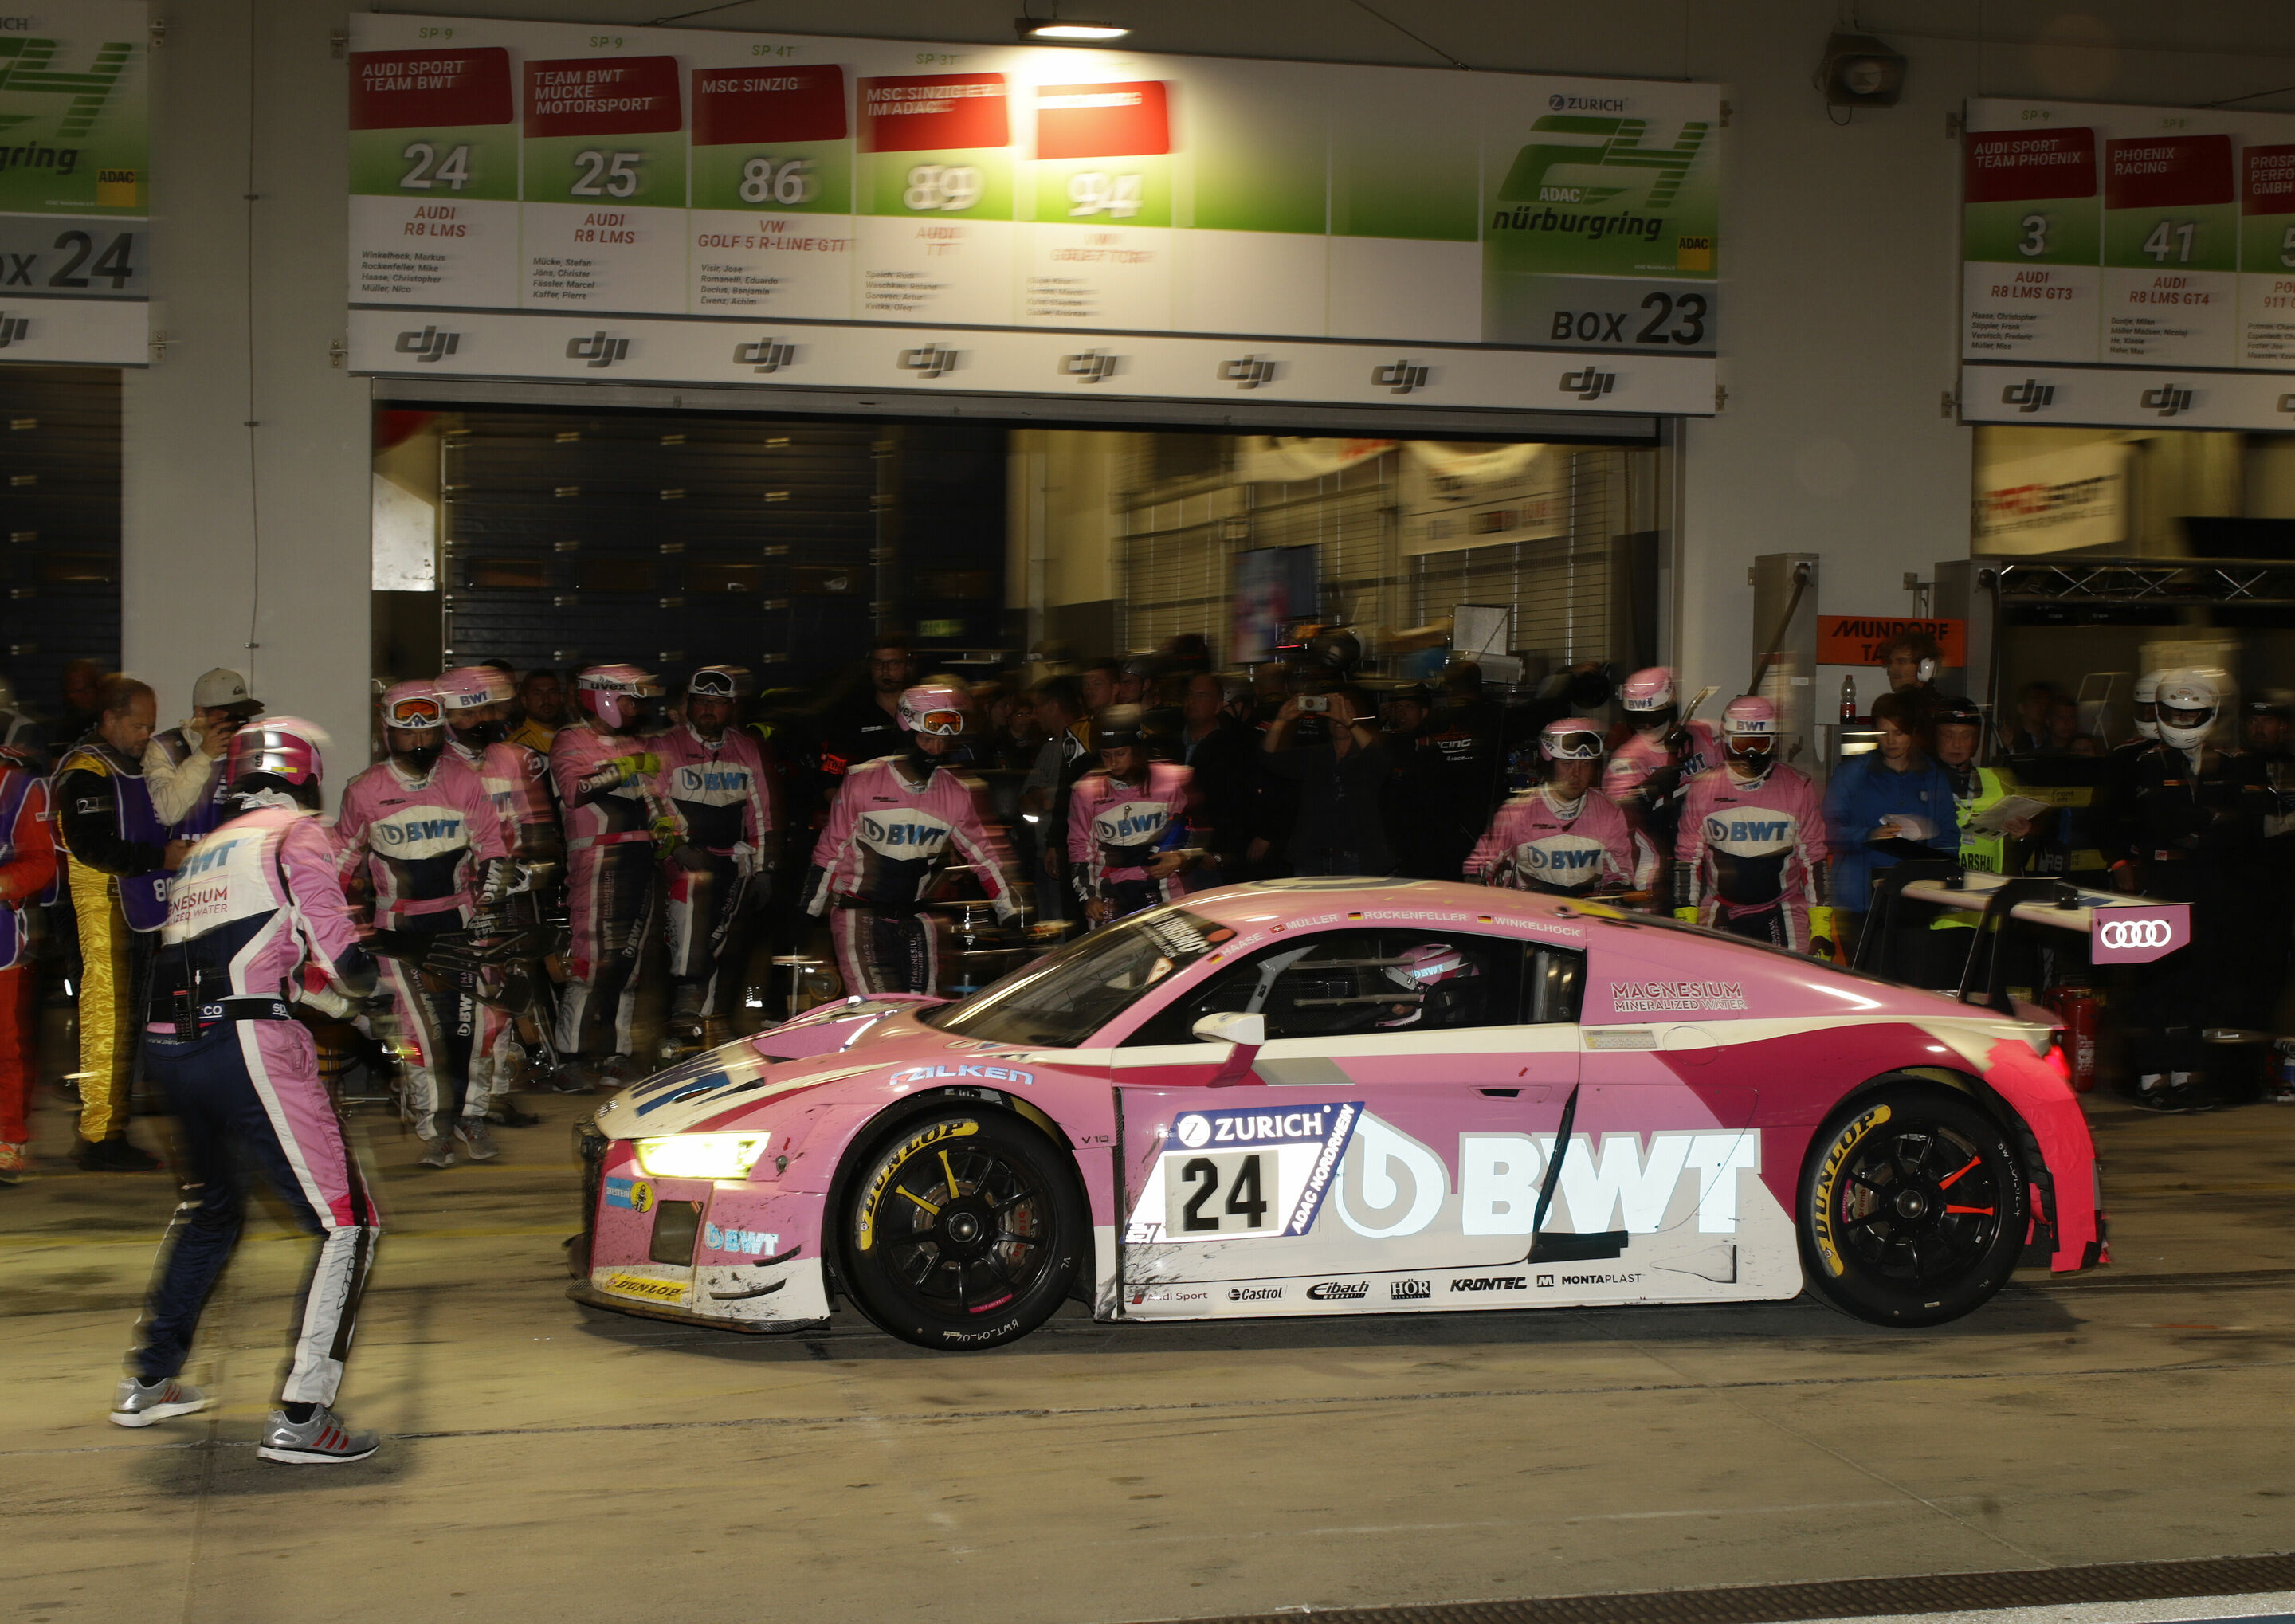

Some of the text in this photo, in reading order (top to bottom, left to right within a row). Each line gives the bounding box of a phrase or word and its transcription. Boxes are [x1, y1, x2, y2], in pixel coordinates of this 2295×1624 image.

[419, 27, 453, 39] SP 9
[589, 37, 622, 48] SP 9
[751, 45, 794, 57] SP 4T
[916, 53, 958, 65] SP 3T
[362, 61, 465, 76] AUDI SPORT
[365, 76, 457, 91] TEAM BWT
[534, 69, 624, 85] TEAM BWT
[701, 77, 798, 94] MSC SINZIG
[866, 84, 959, 102] MSC SINZIG
[536, 97, 653, 115] MOTORSPORT
[868, 100, 936, 116] IM ADAC
[1567, 97, 1623, 112] ZURICH
[2022, 110, 2050, 120] SP 9
[1975, 139, 2059, 155] AUDI SPORT
[2114, 148, 2176, 161] PHOENIX
[400, 144, 468, 190] 24
[1975, 151, 2081, 168] TEAM PHOENIX
[571, 151, 639, 198] 25
[2114, 162, 2168, 175] RACING
[99, 171, 135, 183] ADAC
[740, 159, 803, 205] 86
[903, 165, 979, 210] 89
[1069, 172, 1143, 218] 94
[1539, 186, 1581, 202] ADAC
[2252, 182, 2292, 195] GMBH
[414, 206, 455, 219] AUDI
[584, 214, 625, 226] AUDI
[404, 223, 466, 237] R8 LMS
[759, 220, 785, 233] VW
[1492, 206, 1663, 242] nürburgring
[574, 229, 635, 244] R8 LMS
[916, 226, 956, 239] AUDI
[2018, 215, 2046, 256] 3
[698, 235, 741, 248] GOLF
[745, 237, 754, 249] 5
[759, 237, 814, 252] R-LINE
[1679, 237, 1708, 249] ADAC
[2143, 222, 2194, 262] 41
[49, 230, 133, 289] 24
[392, 274, 441, 284] Christopher
[2015, 272, 2050, 283] AUDI
[2153, 277, 2187, 289] AUDI
[732, 287, 770, 296] Benjamin
[1991, 285, 2073, 300] R8 LMS GT3
[2129, 291, 2210, 306] R8 LMS GT4
[2264, 296, 2285, 308] 911
[1551, 292, 1707, 345] BOX 23
[590, 682, 626, 691] uvex
[460, 691, 487, 706] BWT
[1736, 720, 1766, 732] BWT
[704, 772, 748, 791] BWT
[406, 819, 460, 843] BWT
[1118, 813, 1162, 837] BWT
[1731, 822, 1789, 841] BWT
[886, 824, 947, 846] BWT
[1551, 849, 1601, 869] BWT
[1958, 853, 1994, 873] ARSHAL
[192, 904, 228, 918] WATER
[1363, 911, 1467, 922] ROCKENFELLER
[1285, 913, 1338, 929] MÜLLER
[1493, 916, 1581, 937] WINKELHOCK
[1222, 933, 1262, 956] HAASE
[1611, 982, 1741, 999] MAGNESIUM
[1614, 998, 1748, 1012] MINERALIZED WATER
[889, 1065, 1034, 1085] FALKEN
[1215, 1113, 1323, 1141] ZURICH
[865, 1121, 965, 1216] DUNLOP
[1291, 1103, 1355, 1235] ADAC NORDRHEIN
[1463, 1133, 1756, 1236] BWT
[1816, 1114, 1875, 1241] DUNLOP
[606, 1187, 630, 1198] BILSTEIN
[1181, 1155, 1268, 1232] 24
[724, 1229, 779, 1256] BWT
[1391, 1279, 1430, 1295] HÖR
[1450, 1277, 1527, 1292] KRONTEC
[1562, 1273, 1642, 1285] MONTAPLAST
[616, 1281, 681, 1296] DUNLOP
[1175, 1292, 1208, 1301] Sport
[1241, 1286, 1282, 1300] Castrol
[1307, 1281, 1370, 1300] Eibach
